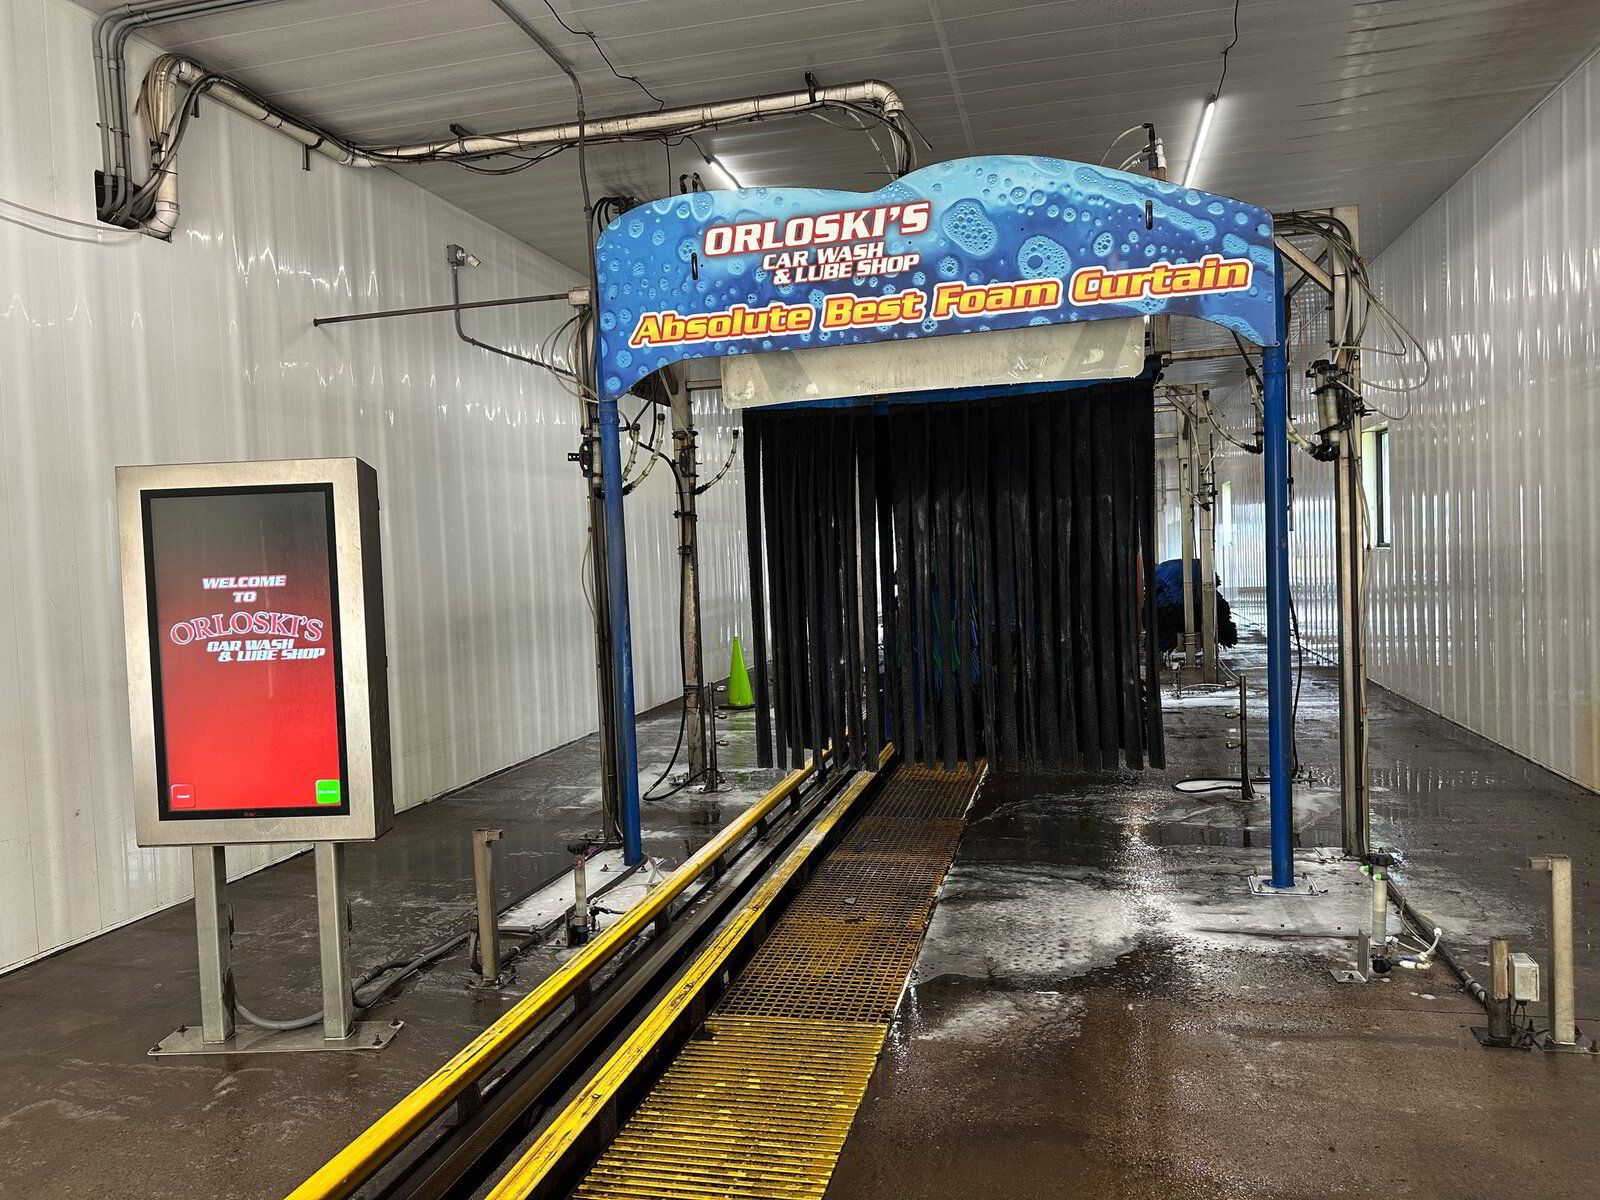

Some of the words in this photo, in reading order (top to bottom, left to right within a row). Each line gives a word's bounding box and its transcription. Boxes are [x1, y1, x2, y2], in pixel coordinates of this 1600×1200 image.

[705, 201, 930, 256] ORLOSKI'S
[762, 251, 809, 270] CAR
[816, 241, 884, 264] WASH
[773, 268, 792, 286] &
[794, 260, 854, 283] LUBE
[857, 254, 920, 277] SHOP
[631, 303, 814, 347] Absolute
[822, 289, 926, 330] Best
[932, 280, 1060, 318] Foam
[1070, 255, 1251, 305] Curtain
[202, 575, 286, 589] WELCOME
[232, 591, 257, 603] TO
[170, 611, 323, 645] ORLOSKI'S
[207, 640, 242, 652] CAR
[245, 638, 295, 651] WASH
[218, 650, 234, 662] &
[236, 649, 279, 662] LUBE
[281, 647, 325, 660] SHOP
